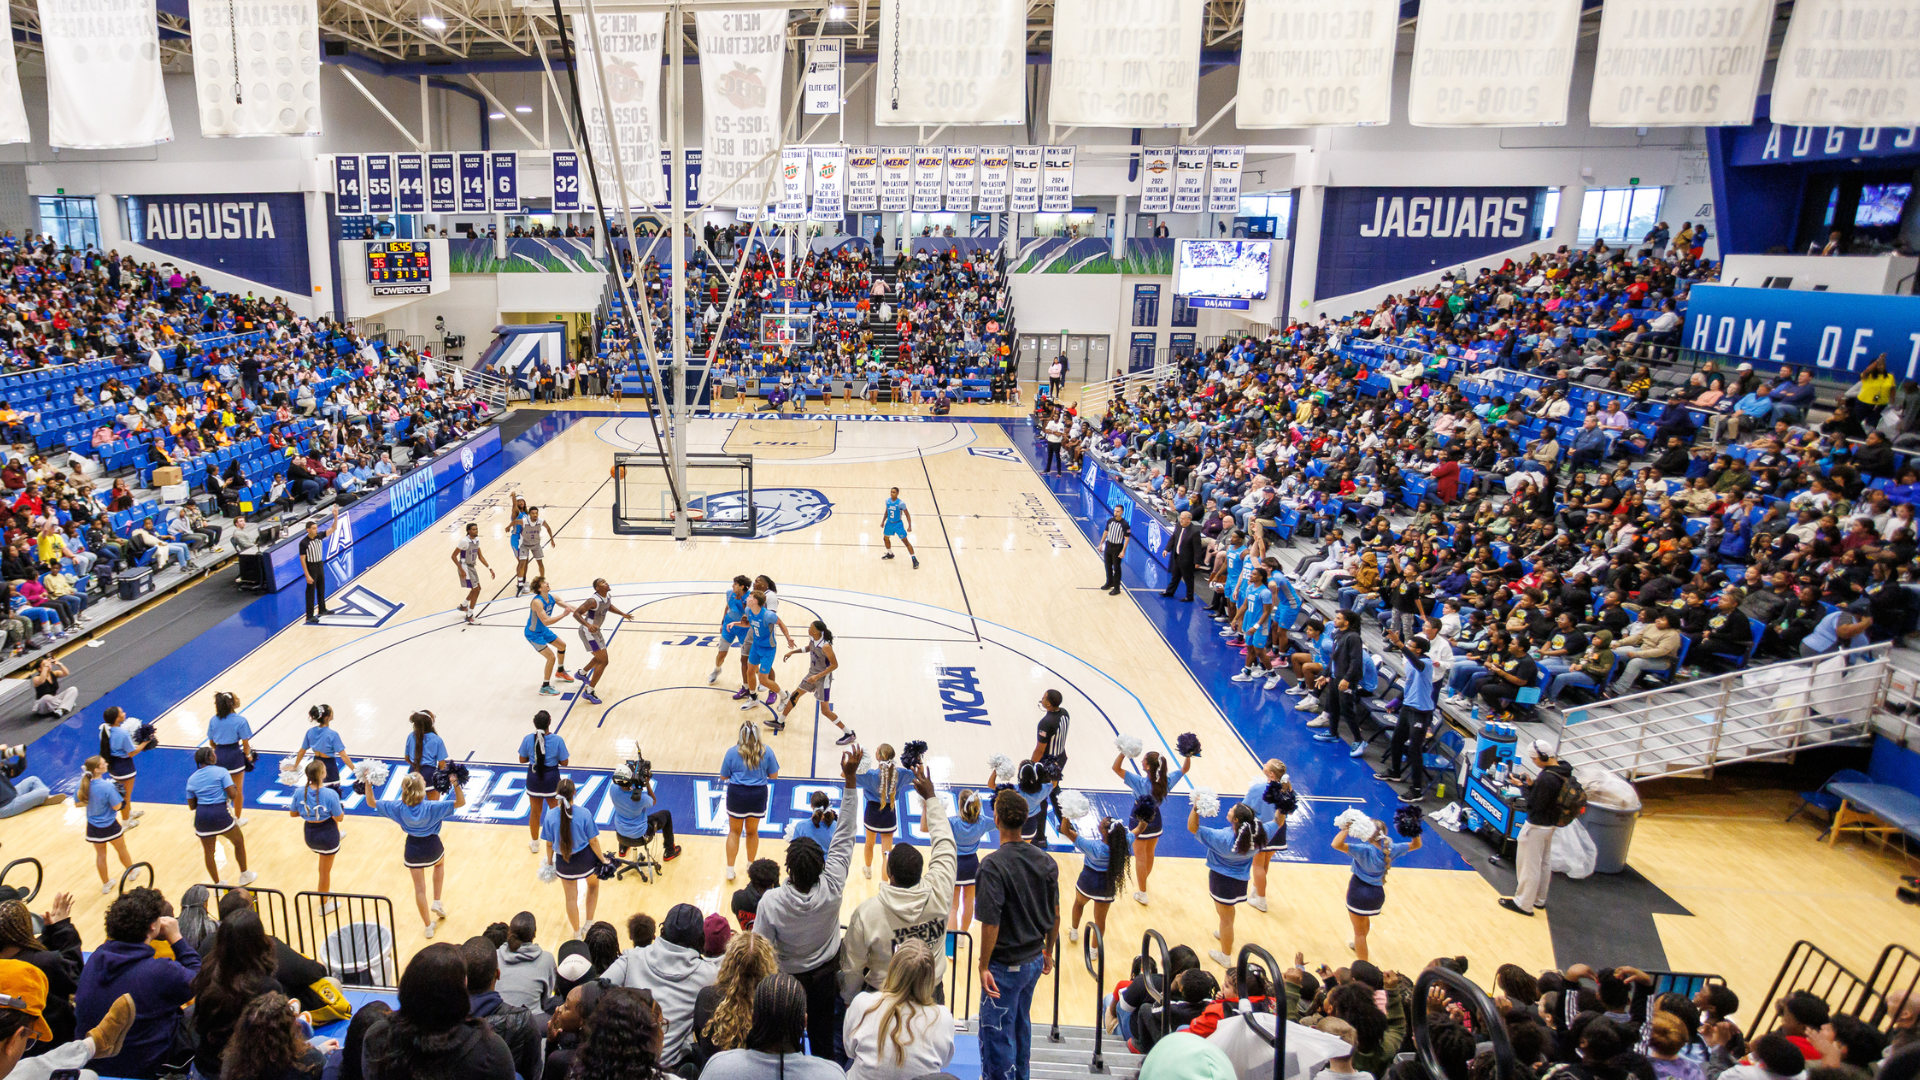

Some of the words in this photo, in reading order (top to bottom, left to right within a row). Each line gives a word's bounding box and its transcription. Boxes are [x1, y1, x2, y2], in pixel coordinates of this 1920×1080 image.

[851, 158, 877, 166] MEAC
[884, 158, 910, 166] MEAC
[917, 158, 942, 166] MEAC
[950, 158, 975, 166] MEAC
[984, 158, 1008, 166] MEAC
[1045, 160, 1070, 168] SLC
[340, 179, 358, 196] 14
[370, 178, 390, 195] 55
[400, 178, 422, 194] 44
[434, 177, 452, 194] 19
[464, 176, 482, 194] 14
[500, 176, 510, 193] 6
[556, 176, 578, 192] 32
[147, 202, 276, 240] AUGUSTA
[1360, 196, 1528, 238] JAGUARS
[389, 242, 412, 252] 16:45
[373, 258, 386, 268] 35
[397, 258, 403, 267] 2
[416, 257, 428, 267] 39
[373, 270, 380, 280] 0
[384, 270, 390, 279] 3
[412, 270, 418, 278] 3
[424, 270, 429, 278] 1
[375, 286, 428, 295] POWERADE
[785, 286, 794, 298] 13
[1691, 314, 1792, 362] HOME
[1816, 326, 1874, 371] OF
[793, 412, 925, 423] JAGUARS
[389, 464, 436, 518] AUGUSTA
[890, 510, 894, 518] 3
[326, 511, 354, 561] A
[1242, 568, 1252, 580] 22
[1248, 600, 1254, 612] 11
[935, 664, 992, 727] NCAA
[1470, 788, 1503, 821] POWERADE
[892, 916, 938, 938] JASON
